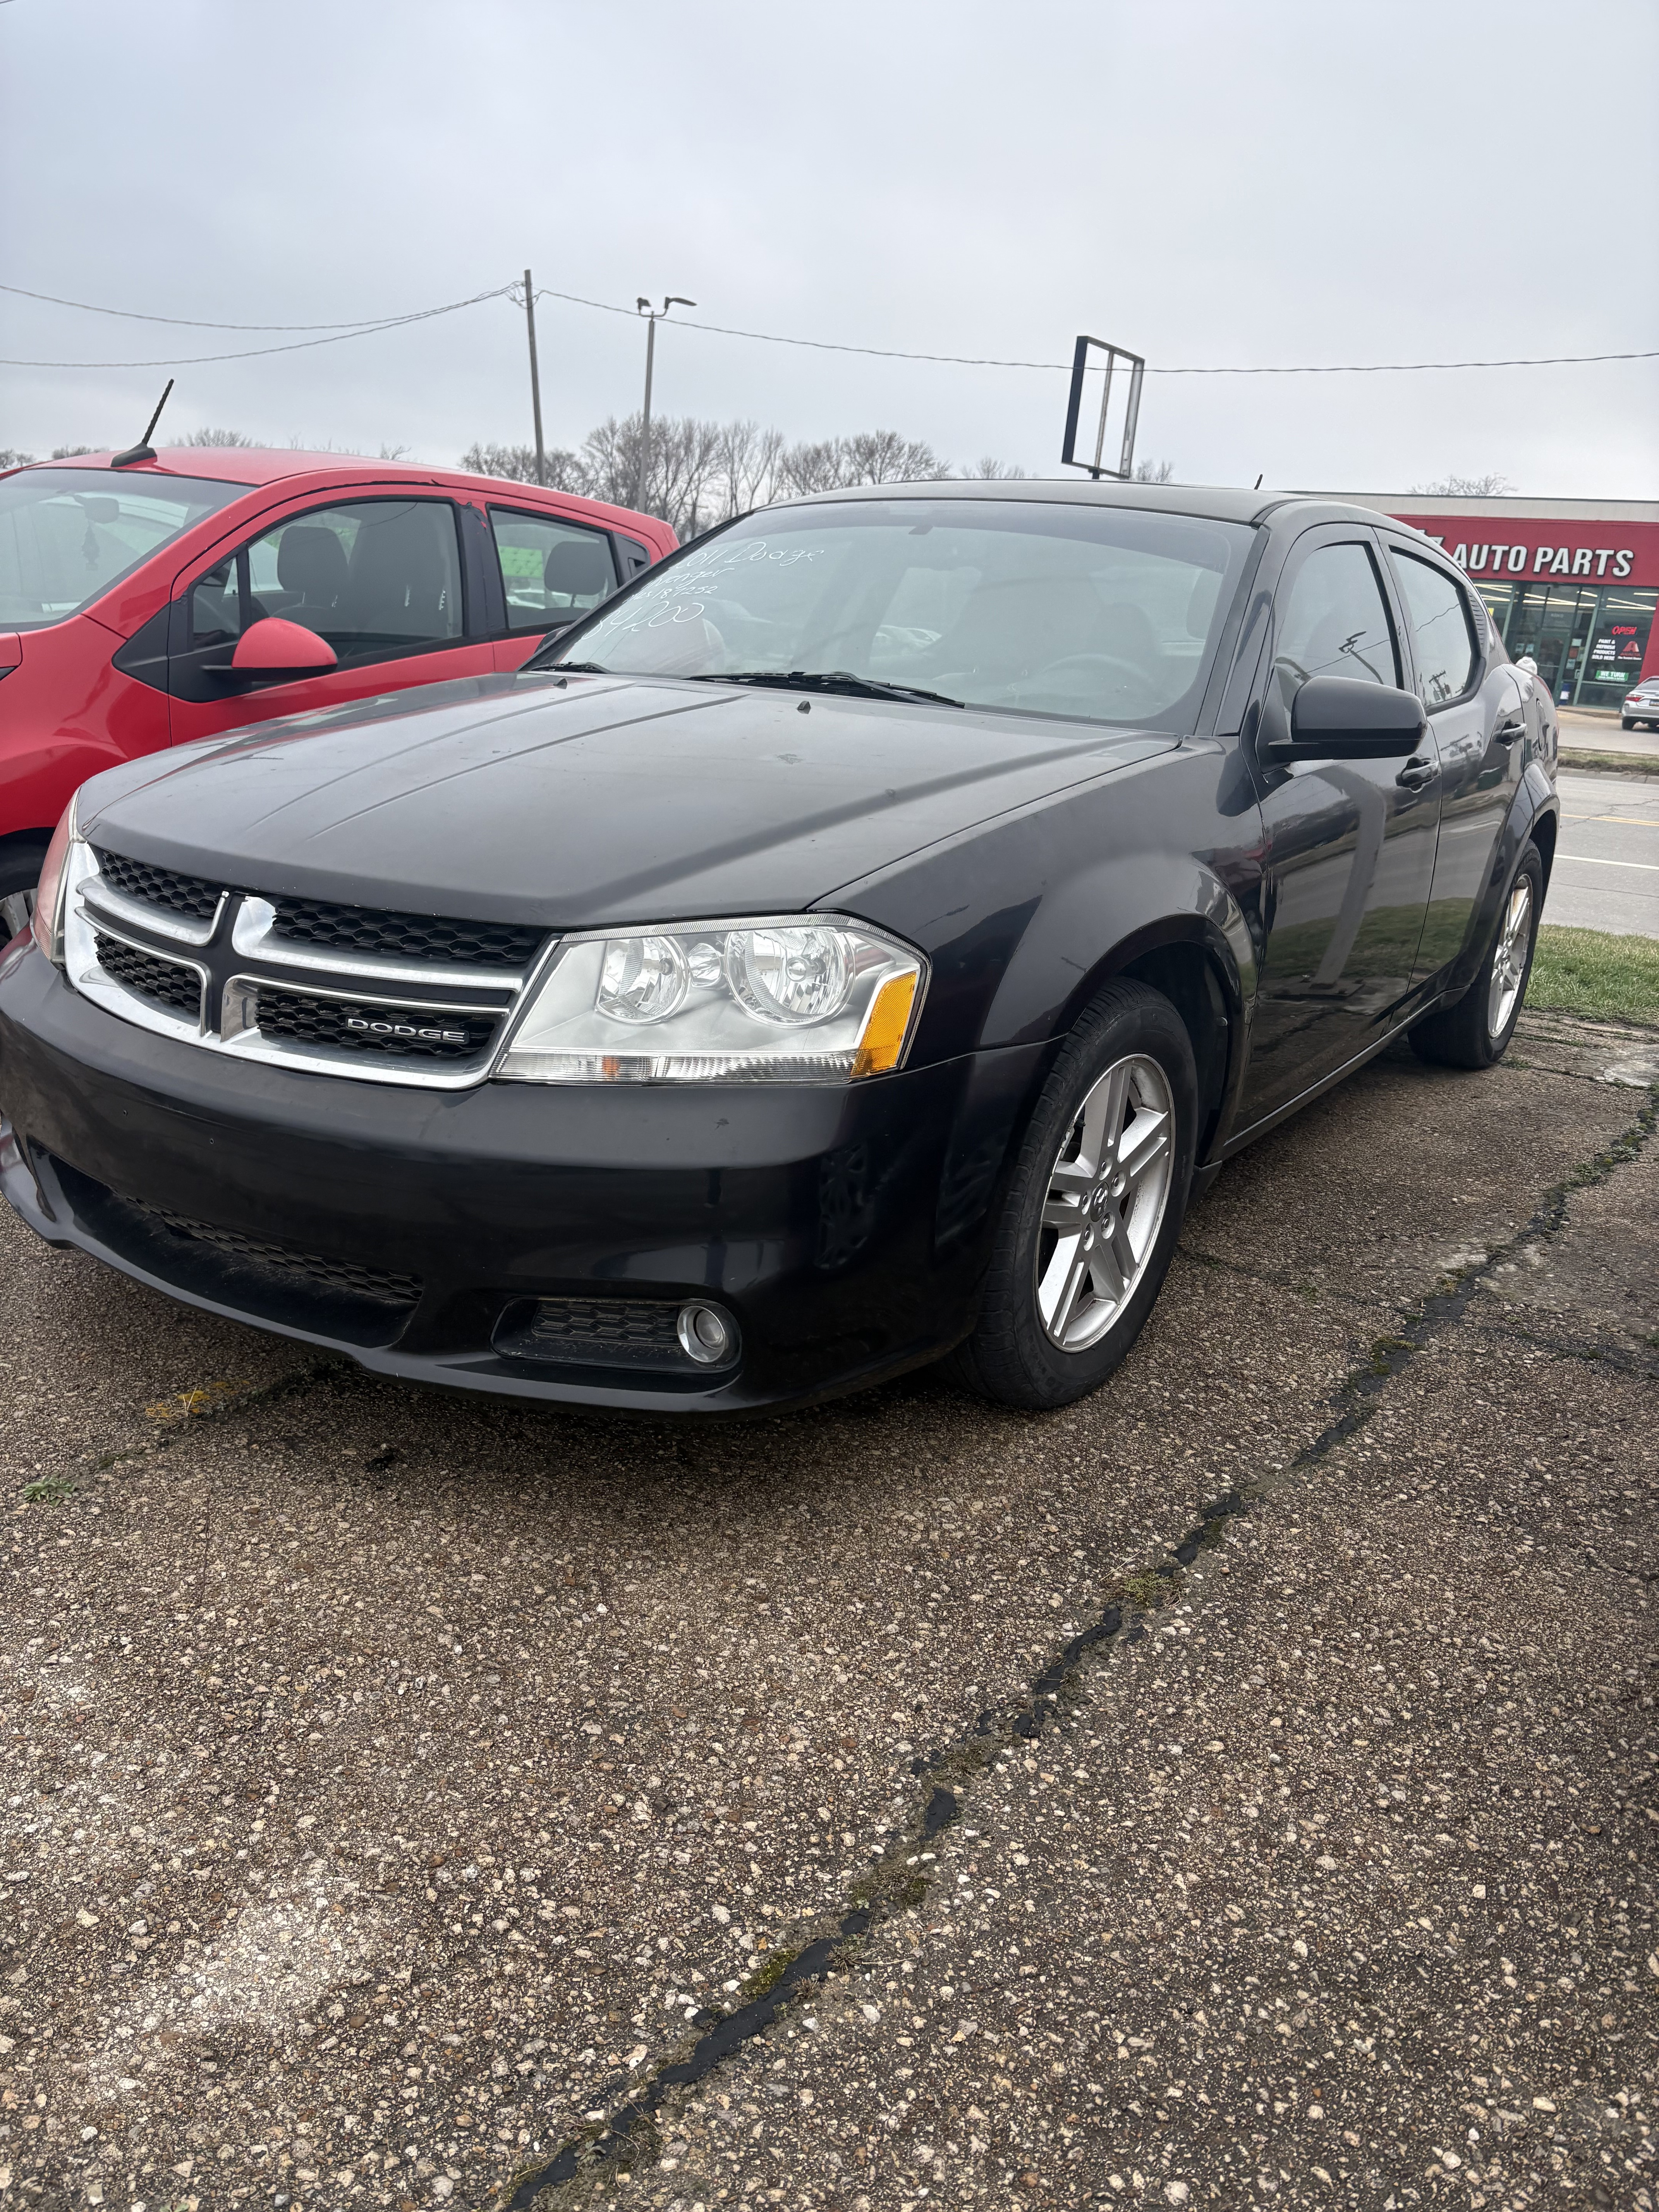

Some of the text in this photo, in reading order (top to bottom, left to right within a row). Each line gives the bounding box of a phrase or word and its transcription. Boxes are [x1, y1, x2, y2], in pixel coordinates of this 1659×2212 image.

[724, 542, 824, 566] Dodge
[1452, 543, 1634, 577] AUTO PARTS
[652, 586, 718, 599] 187252
[1611, 626, 1637, 635] OPEN
[347, 1018, 465, 1042] DODGE
